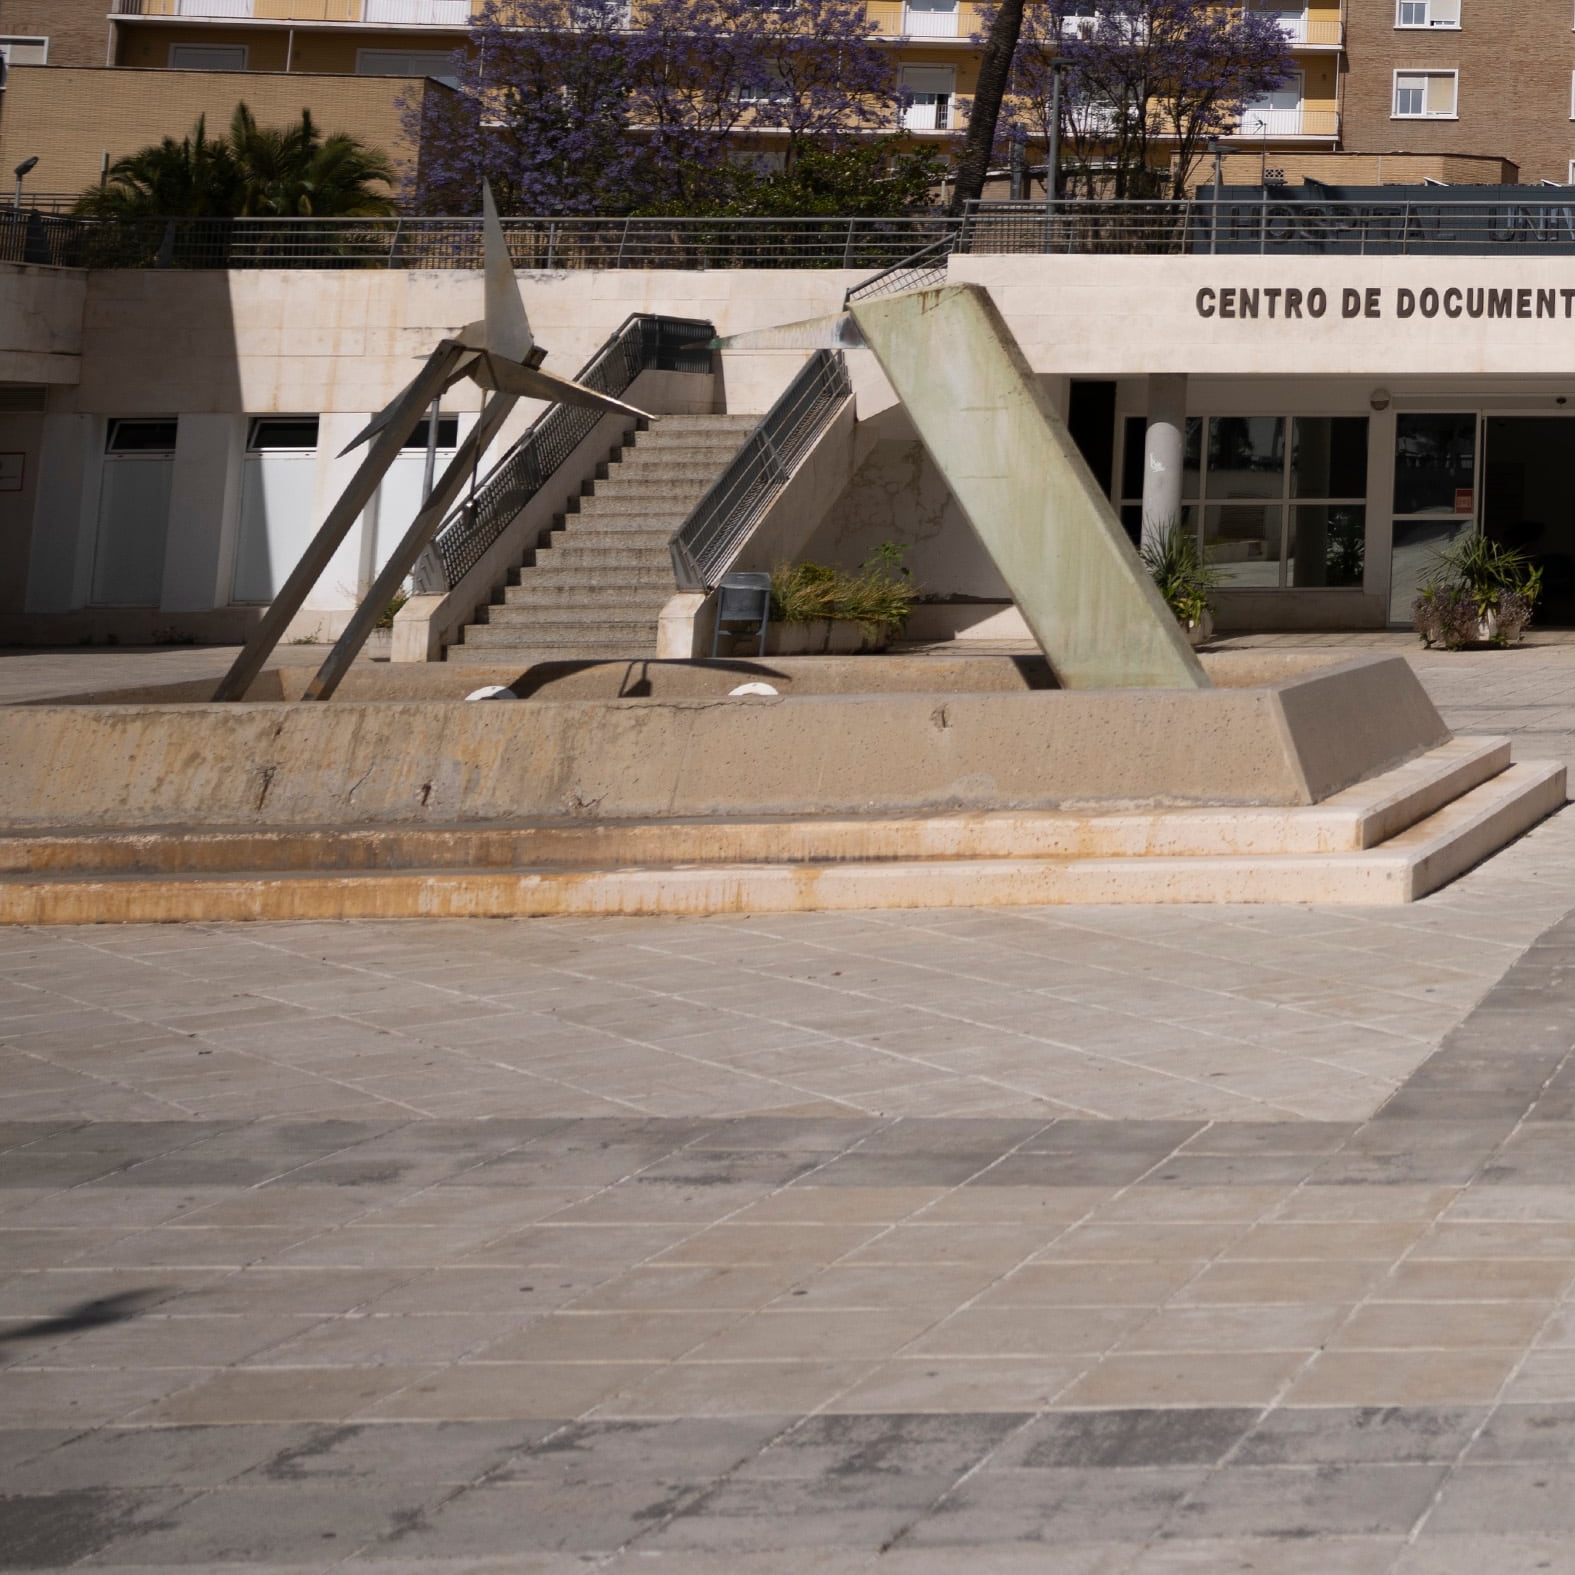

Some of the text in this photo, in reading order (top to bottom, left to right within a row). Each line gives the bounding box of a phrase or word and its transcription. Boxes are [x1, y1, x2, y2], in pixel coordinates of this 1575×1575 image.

[1231, 206, 1455, 241] HOSPITAL
[1195, 287, 1327, 319] CENTRO
[1341, 287, 1381, 318] DE
